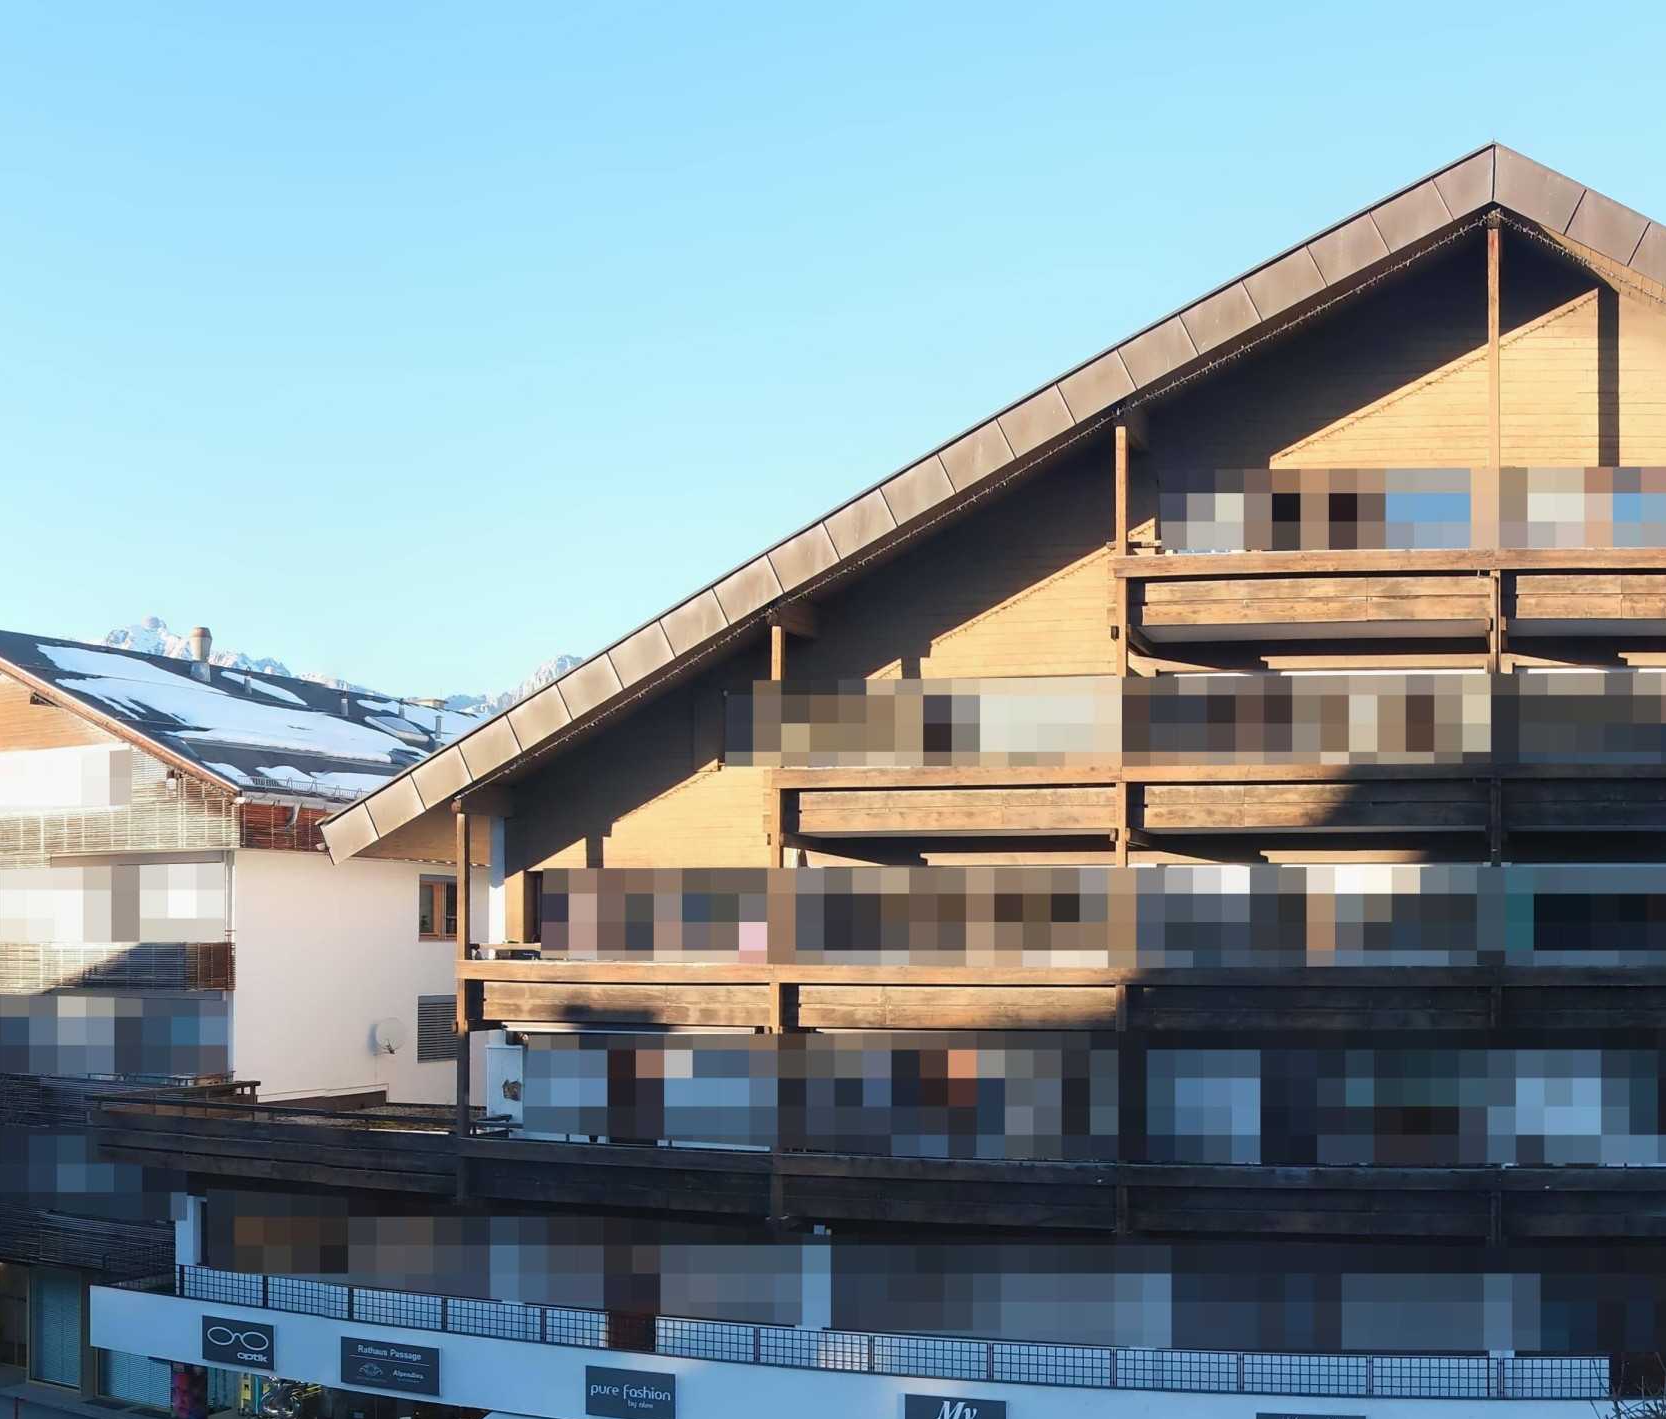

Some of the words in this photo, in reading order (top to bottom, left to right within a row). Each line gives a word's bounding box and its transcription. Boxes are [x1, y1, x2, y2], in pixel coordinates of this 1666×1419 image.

[237, 1351, 268, 1363] optik
[358, 1344, 387, 1356] Rathaus
[390, 1349, 422, 1361] Passage
[590, 1384, 619, 1396] pure
[623, 1384, 671, 1401] fashion
